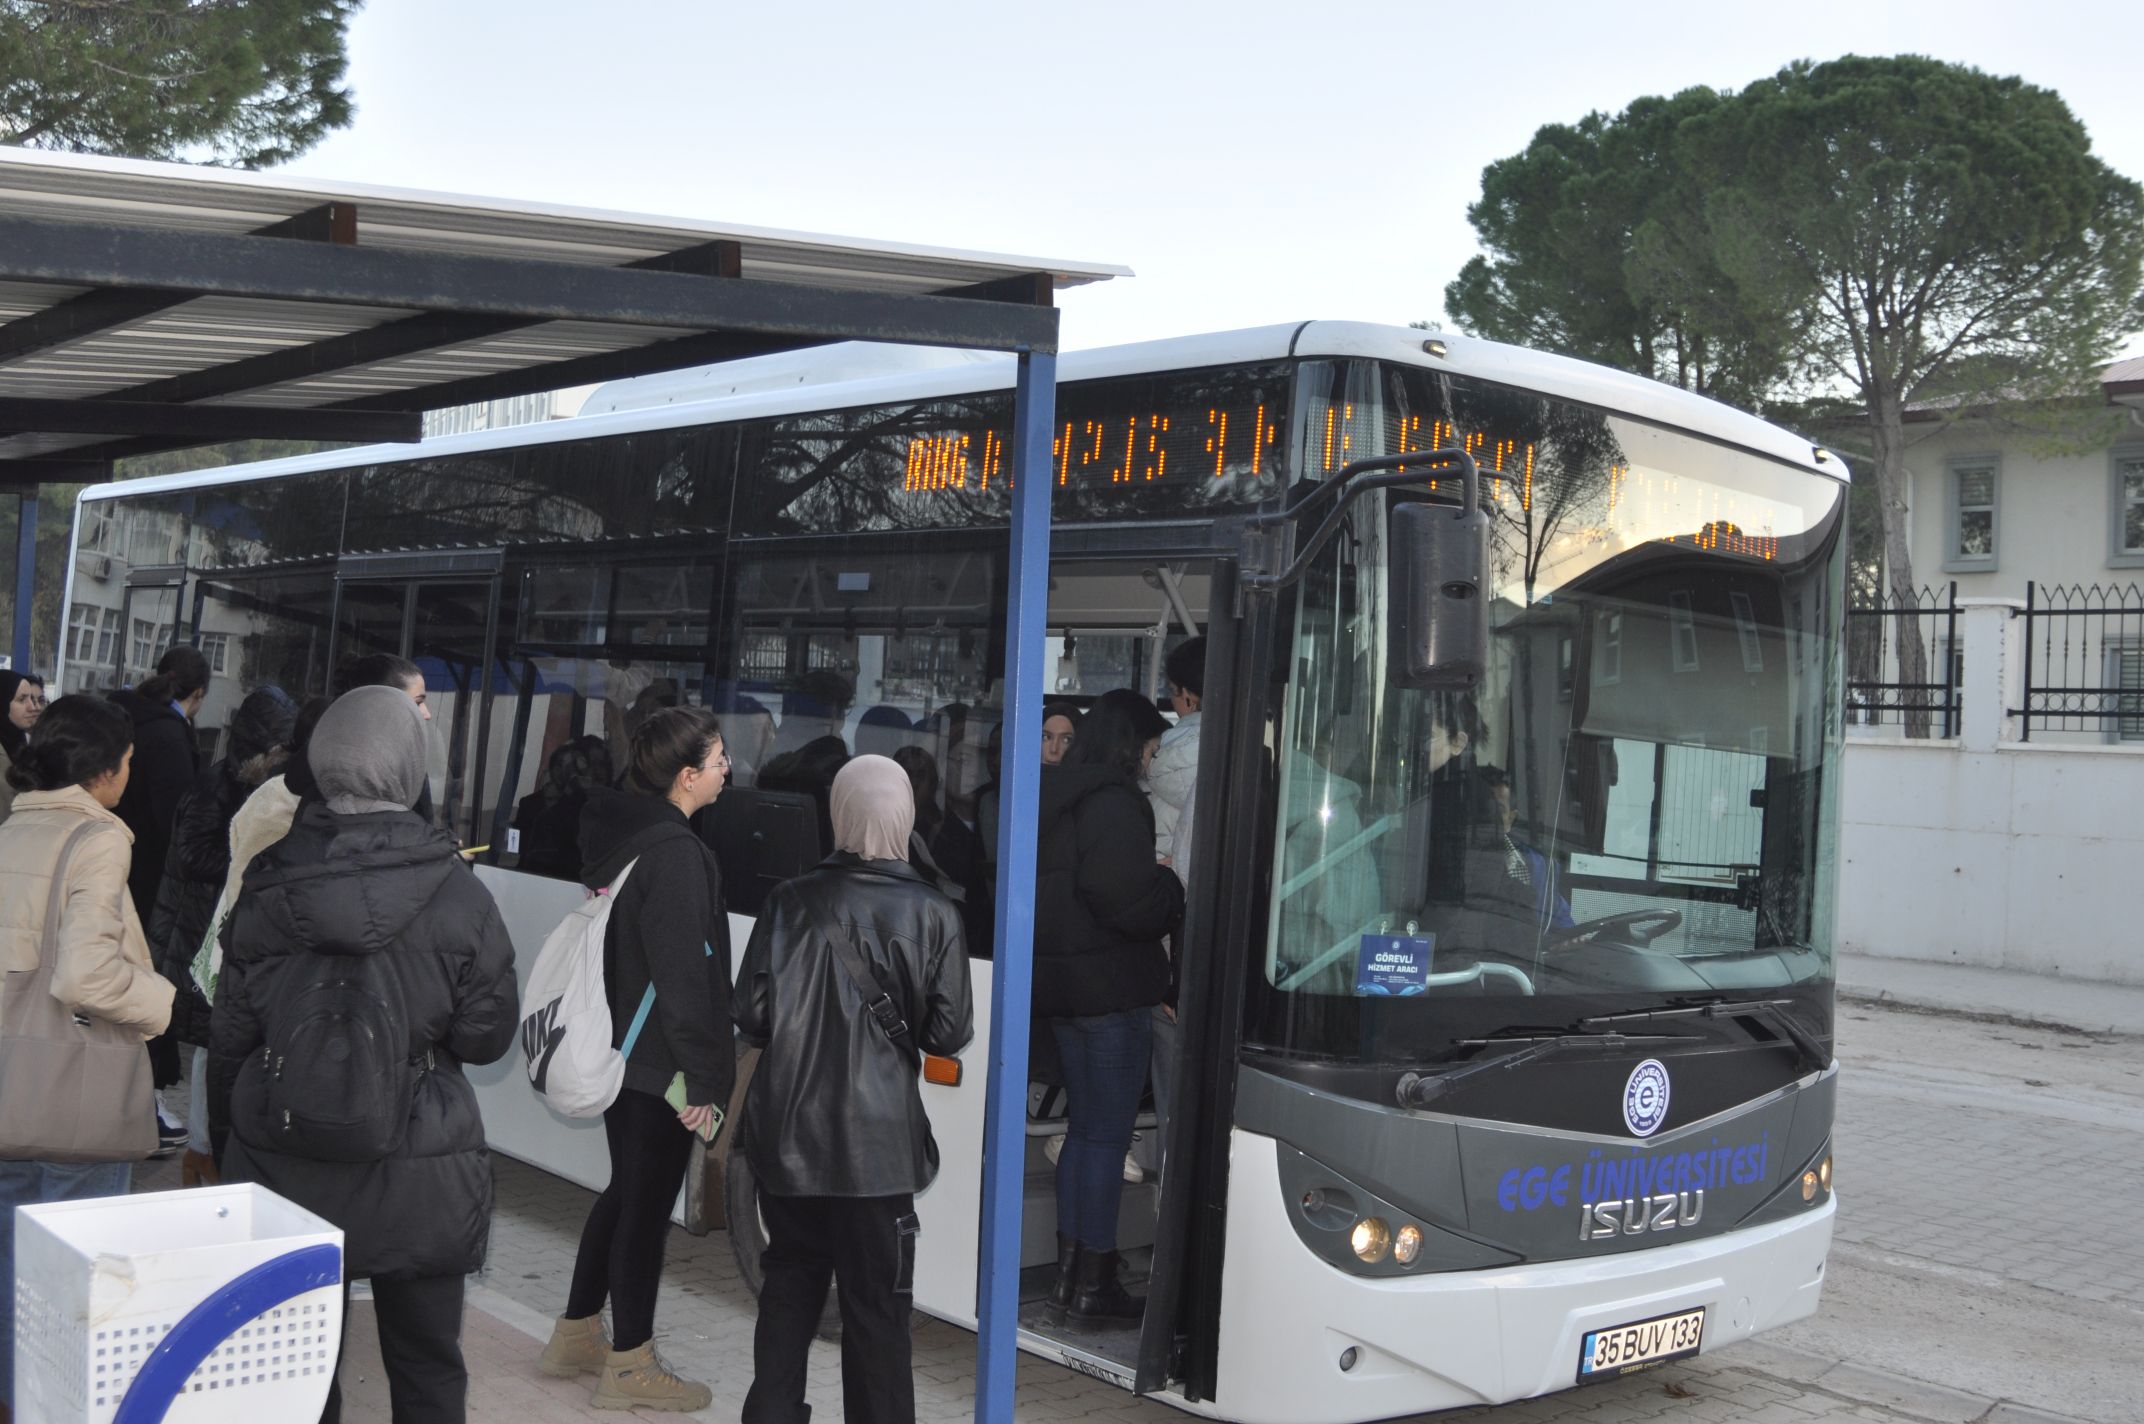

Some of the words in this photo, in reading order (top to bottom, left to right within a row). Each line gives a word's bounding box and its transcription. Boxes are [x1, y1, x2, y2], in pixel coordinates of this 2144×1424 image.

[1368, 963, 1395, 973] HİZMET
[1375, 952, 1413, 964] GÖREVLİ
[1498, 1164, 1571, 1211] EGE
[1580, 1132, 1767, 1203] ÜNİVERSİTESİ
[1579, 1190, 1704, 1241] ISUZU
[1595, 1332, 1621, 1367] 35
[1622, 1322, 1667, 1361] BUV
[1670, 1315, 1700, 1350] 133
